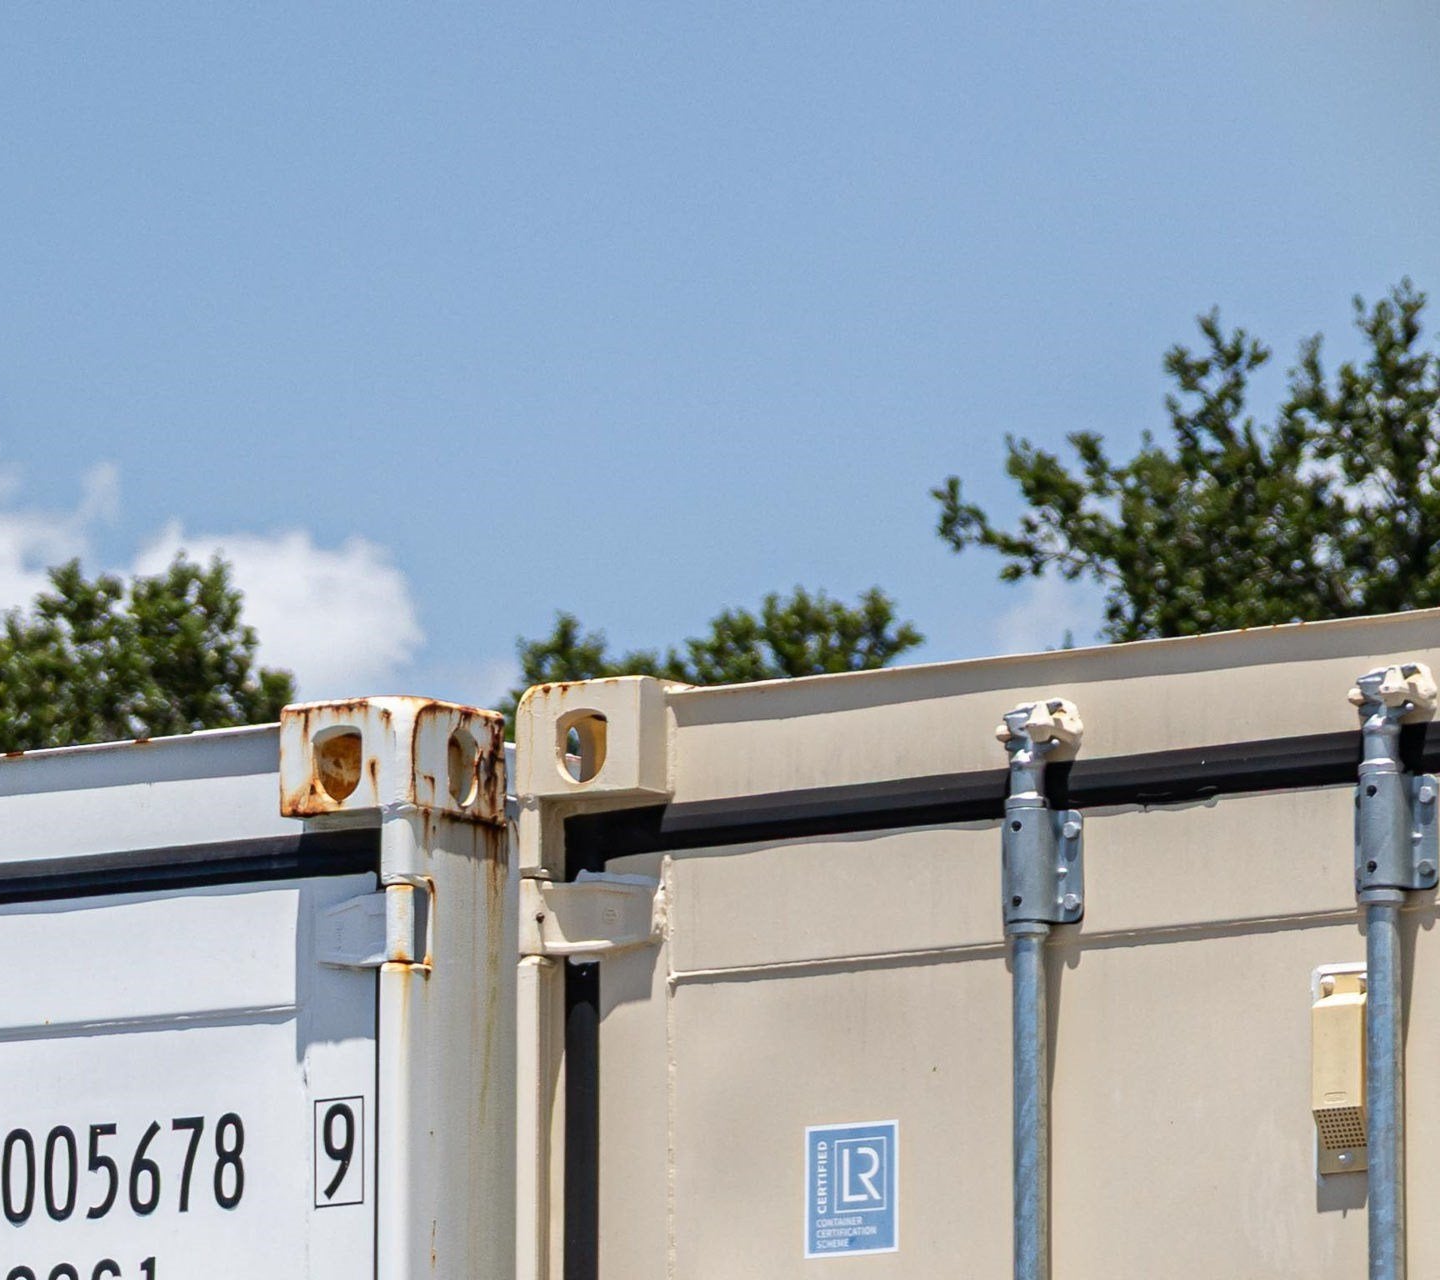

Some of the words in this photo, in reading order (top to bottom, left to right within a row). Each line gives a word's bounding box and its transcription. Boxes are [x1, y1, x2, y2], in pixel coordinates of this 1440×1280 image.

[1, 1111, 245, 1225] 005678
[323, 1103, 355, 1200] 9
[817, 1141, 827, 1213] CERTIFIED
[843, 1147, 882, 1202] LR
[816, 1216, 863, 1228] CONTAINER
[816, 1226, 877, 1238] CERTIFICATION
[816, 1238, 849, 1249] SCHEME
